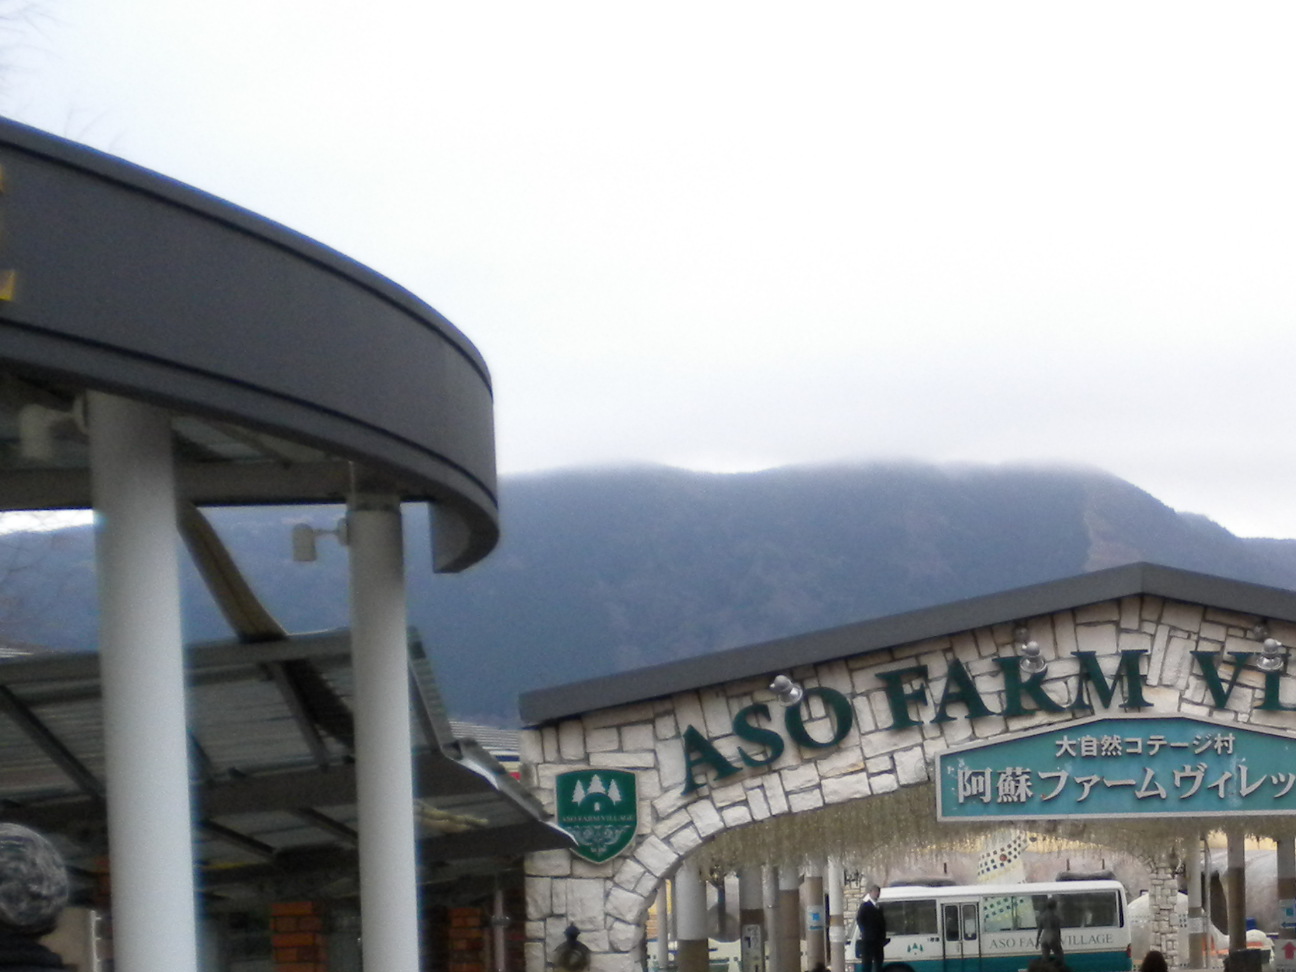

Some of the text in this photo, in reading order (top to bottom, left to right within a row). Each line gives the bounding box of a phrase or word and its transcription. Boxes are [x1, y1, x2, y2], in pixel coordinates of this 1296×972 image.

[682, 686, 853, 796] ASO
[874, 649, 1154, 731] FARM
[1055, 732, 1236, 758] 大自然コテージ村
[989, 938, 1016, 949] ASO
[1061, 933, 1114, 946] VILLAGE
